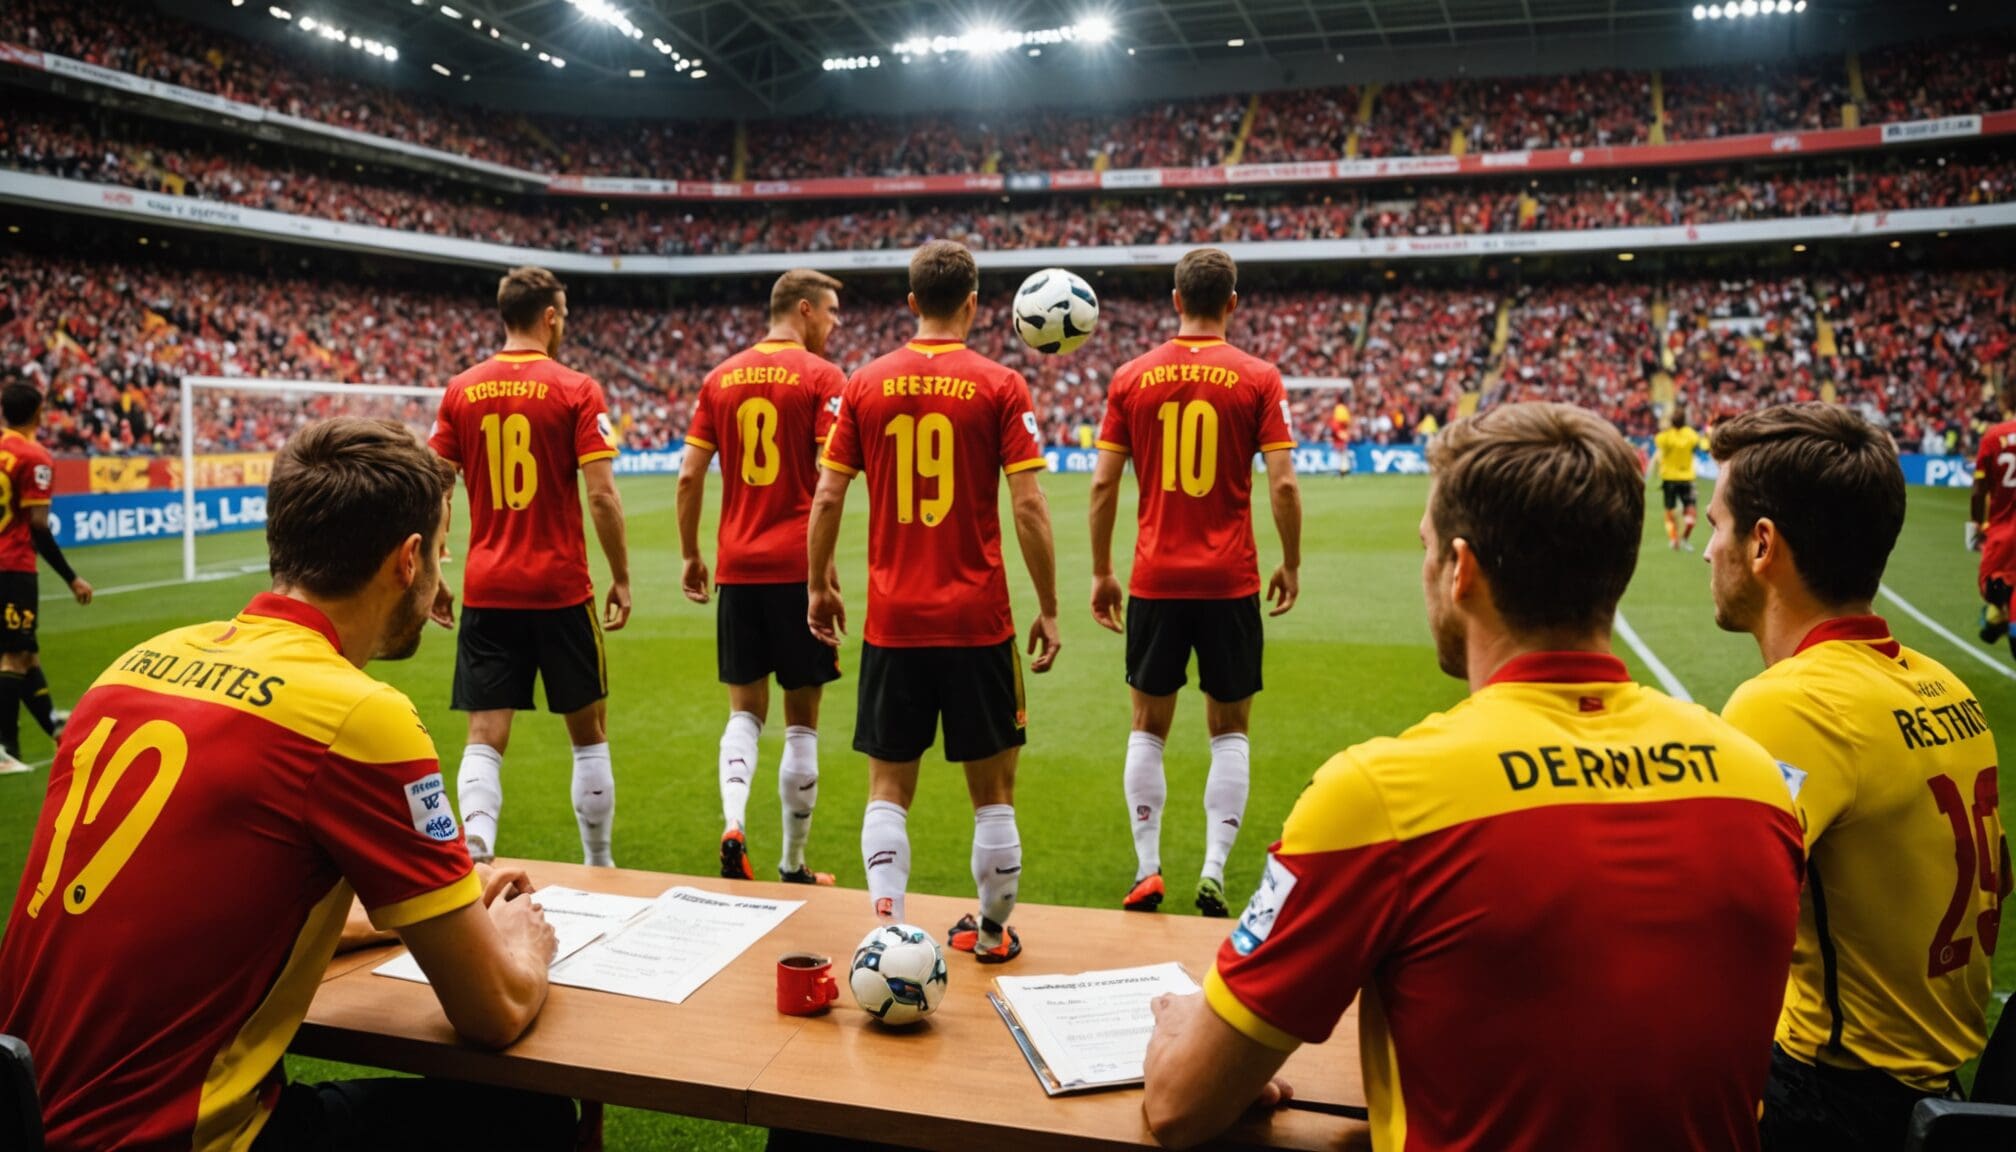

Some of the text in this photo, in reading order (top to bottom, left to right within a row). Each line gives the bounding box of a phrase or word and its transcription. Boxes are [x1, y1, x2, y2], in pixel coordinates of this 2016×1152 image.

[480, 412, 538, 511] 18
[885, 412, 954, 527] 19
[1157, 399, 1219, 498] 10
